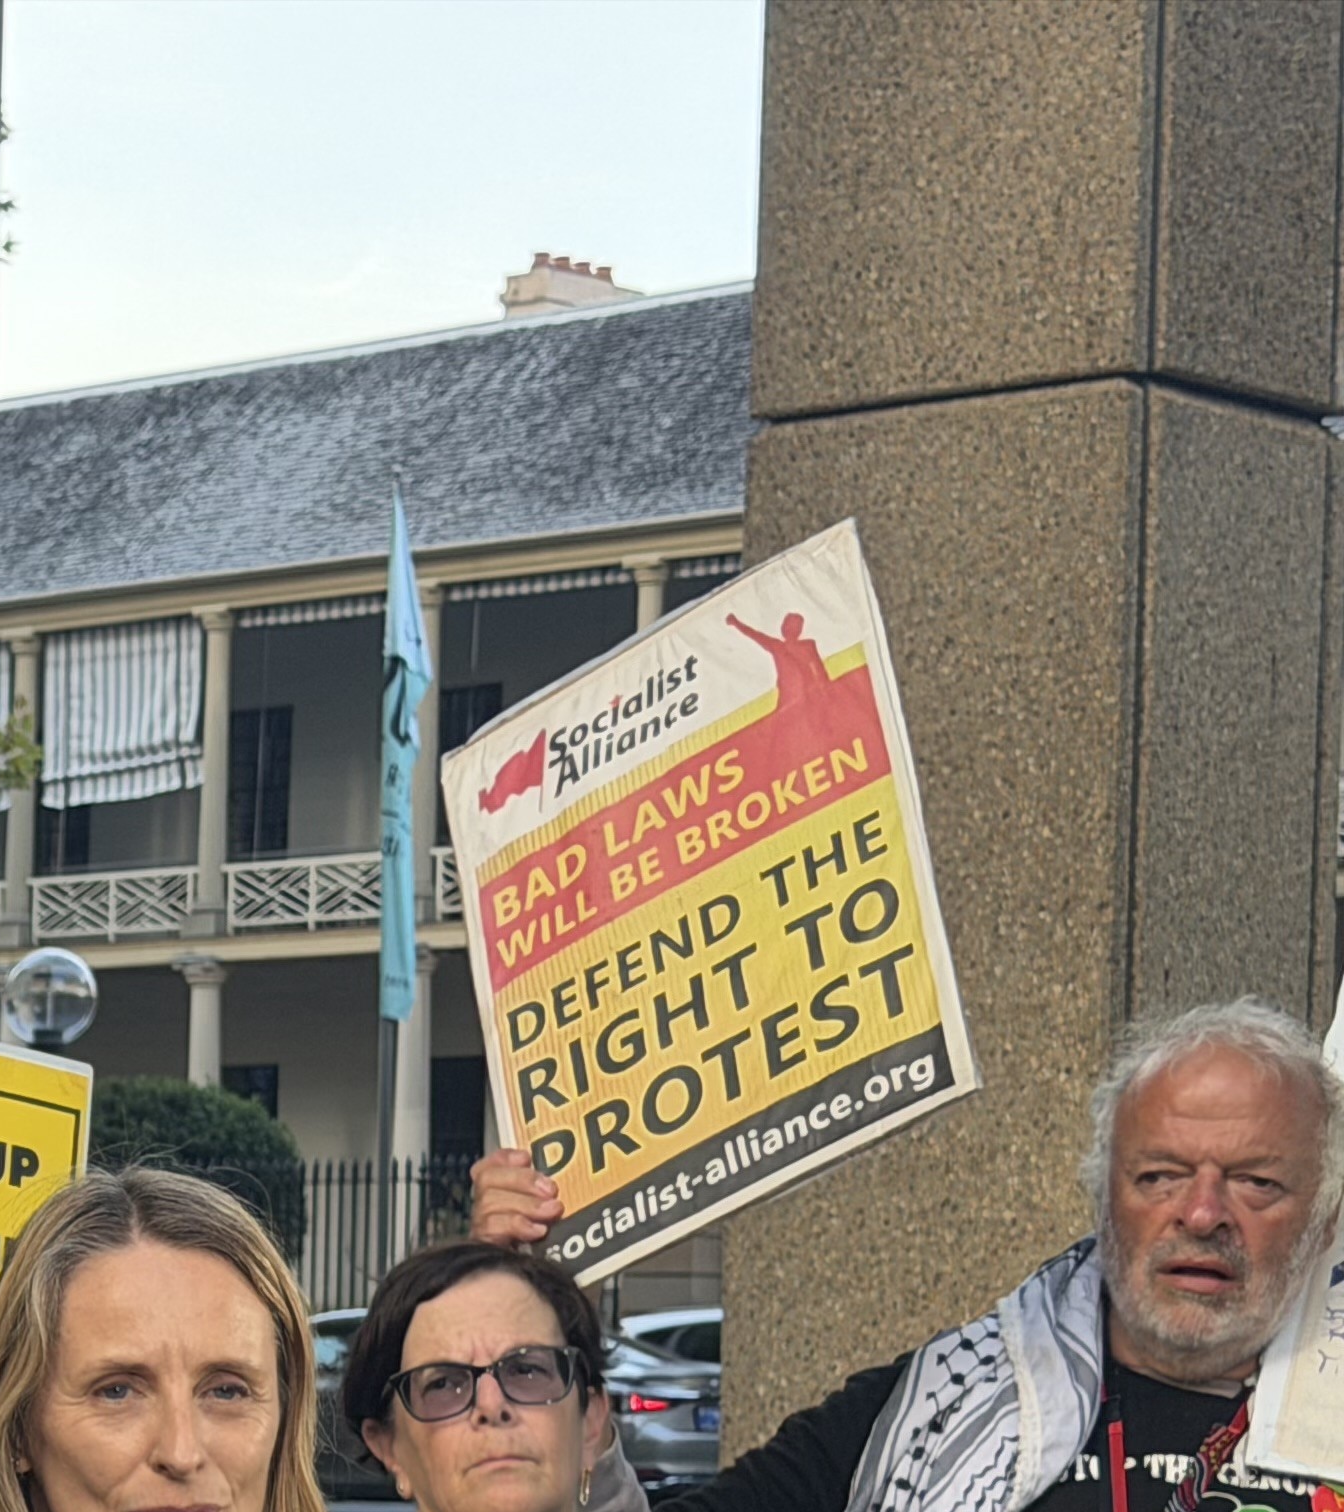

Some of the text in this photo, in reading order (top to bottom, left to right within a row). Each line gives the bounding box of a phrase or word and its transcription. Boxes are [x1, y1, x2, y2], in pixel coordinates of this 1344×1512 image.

[548, 655, 698, 769] Socialist
[554, 692, 699, 798] Alliance
[493, 748, 745, 928] BAD LAWS
[496, 737, 869, 969] WILL BE BROKEN
[506, 810, 888, 1053] DEFEND THE
[517, 878, 900, 1124] RIGHT TO
[530, 944, 914, 1177] PROTEST
